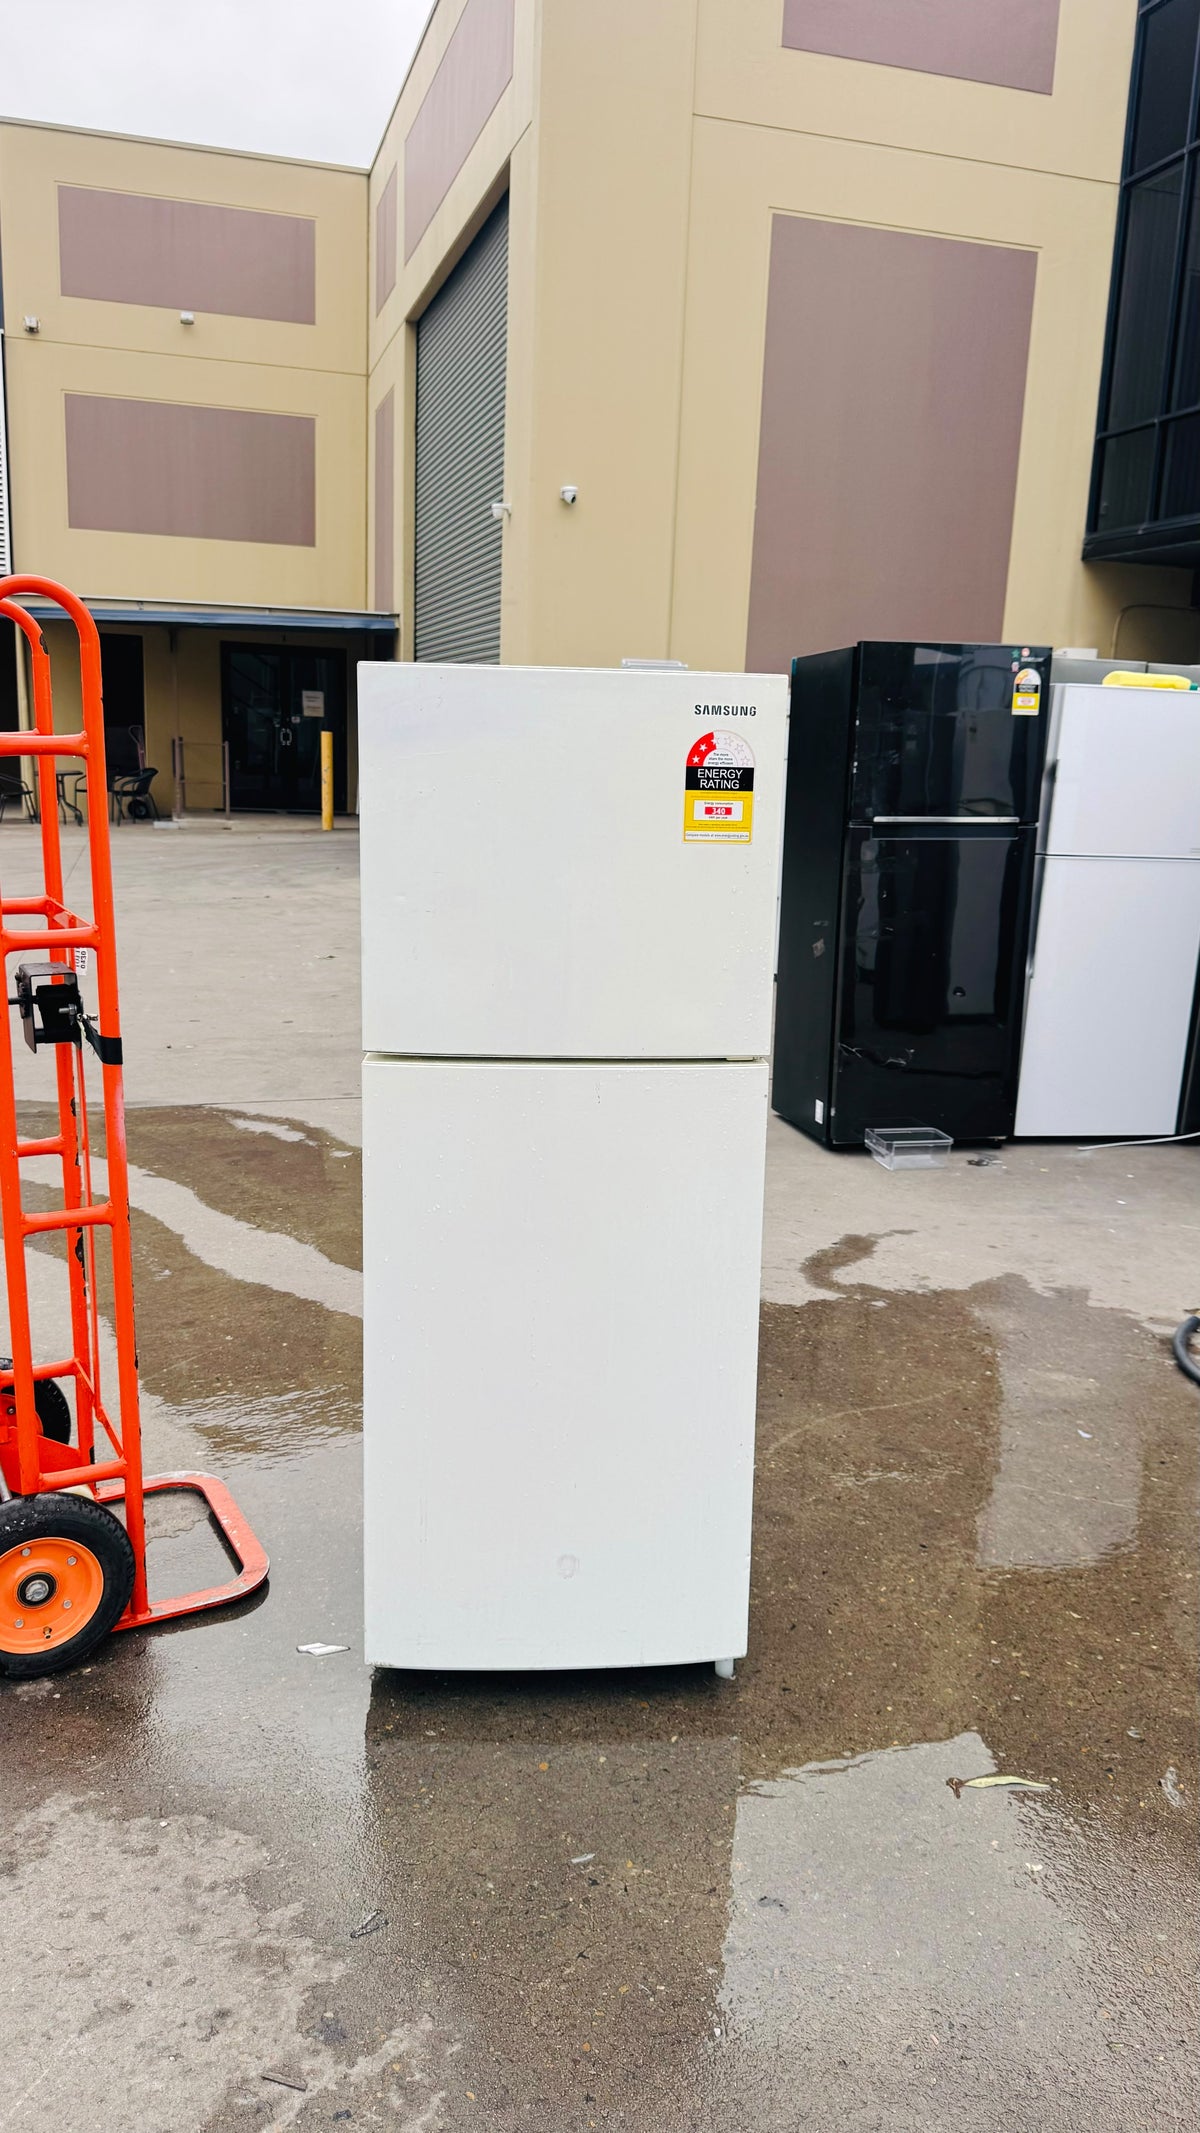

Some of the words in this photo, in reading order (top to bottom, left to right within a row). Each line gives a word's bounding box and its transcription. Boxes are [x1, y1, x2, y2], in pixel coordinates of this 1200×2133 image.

[694, 704, 757, 717] SAMSUNG
[697, 768, 743, 779] ENERGY
[700, 779, 740, 789] RATING
[712, 807, 726, 815] 340
